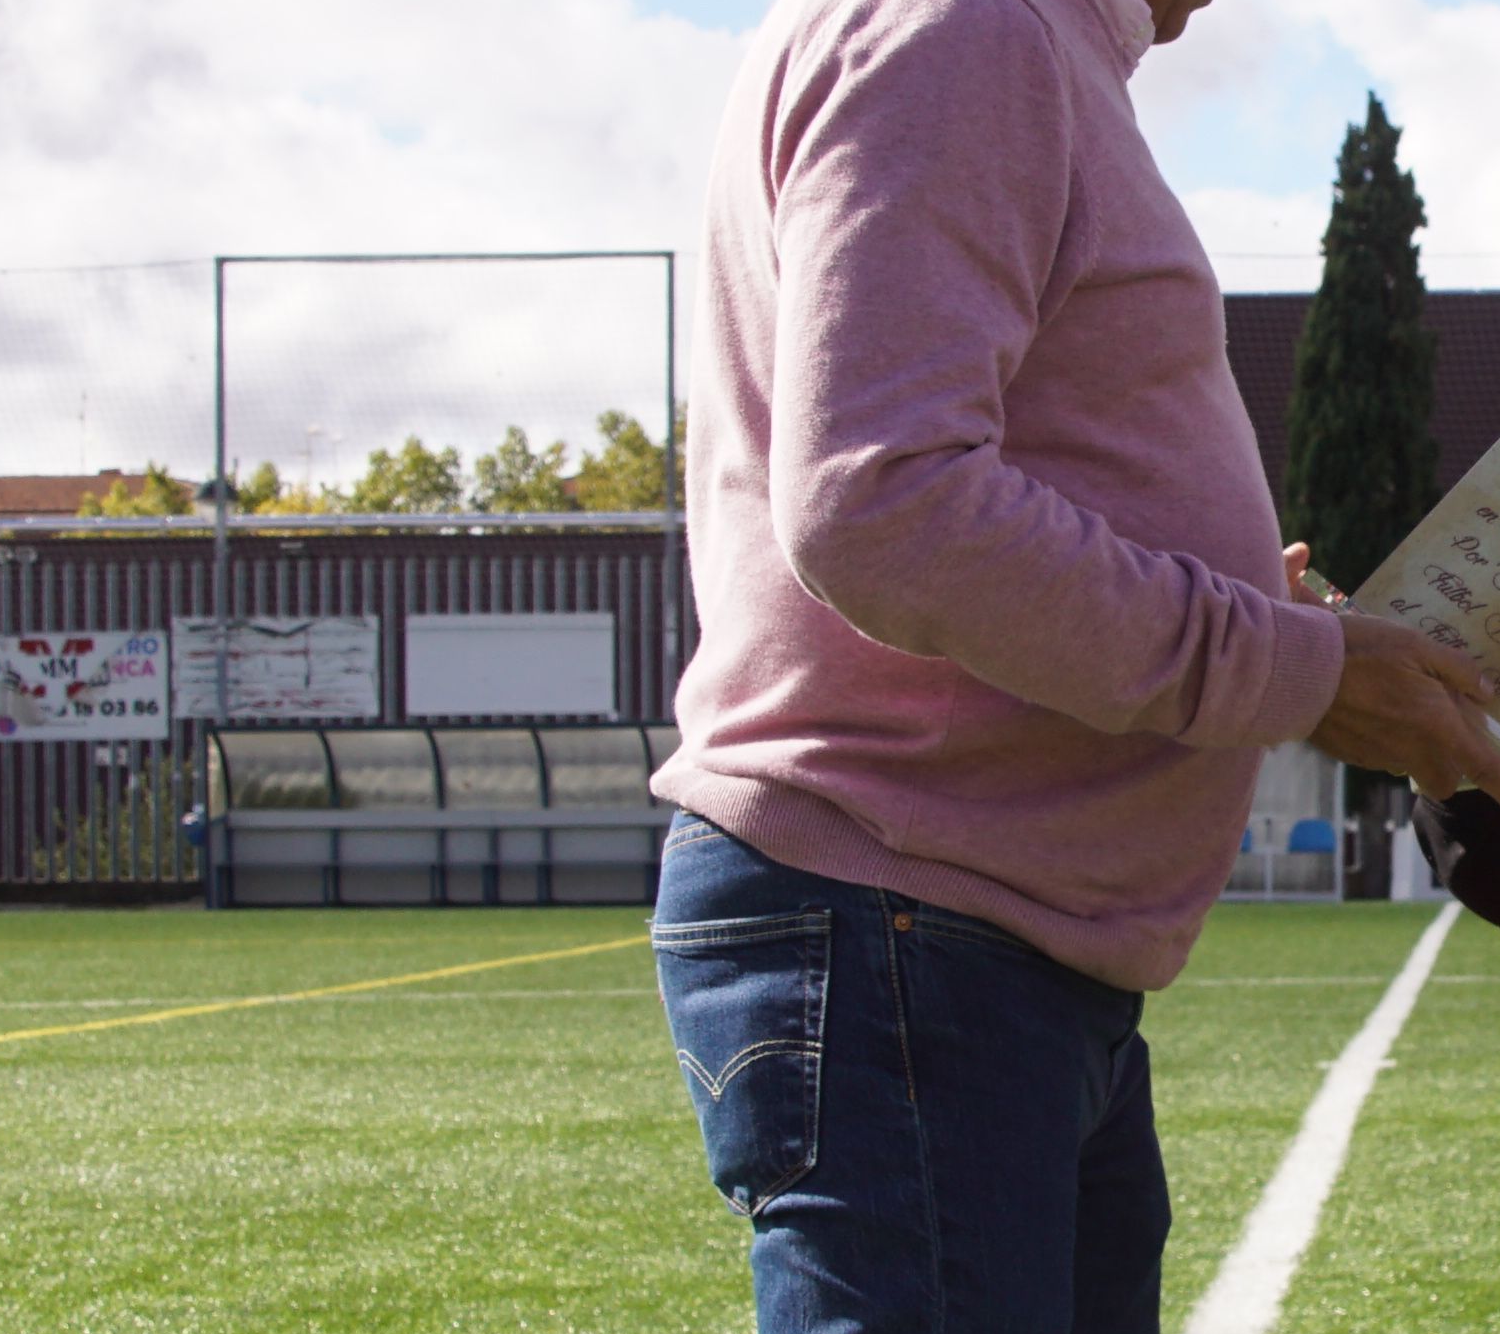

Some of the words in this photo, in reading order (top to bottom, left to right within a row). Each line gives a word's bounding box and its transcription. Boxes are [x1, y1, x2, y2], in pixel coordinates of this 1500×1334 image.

[1476, 506, 1499, 524] en
[1450, 534, 1489, 567] Por
[1389, 598, 1423, 616] al
